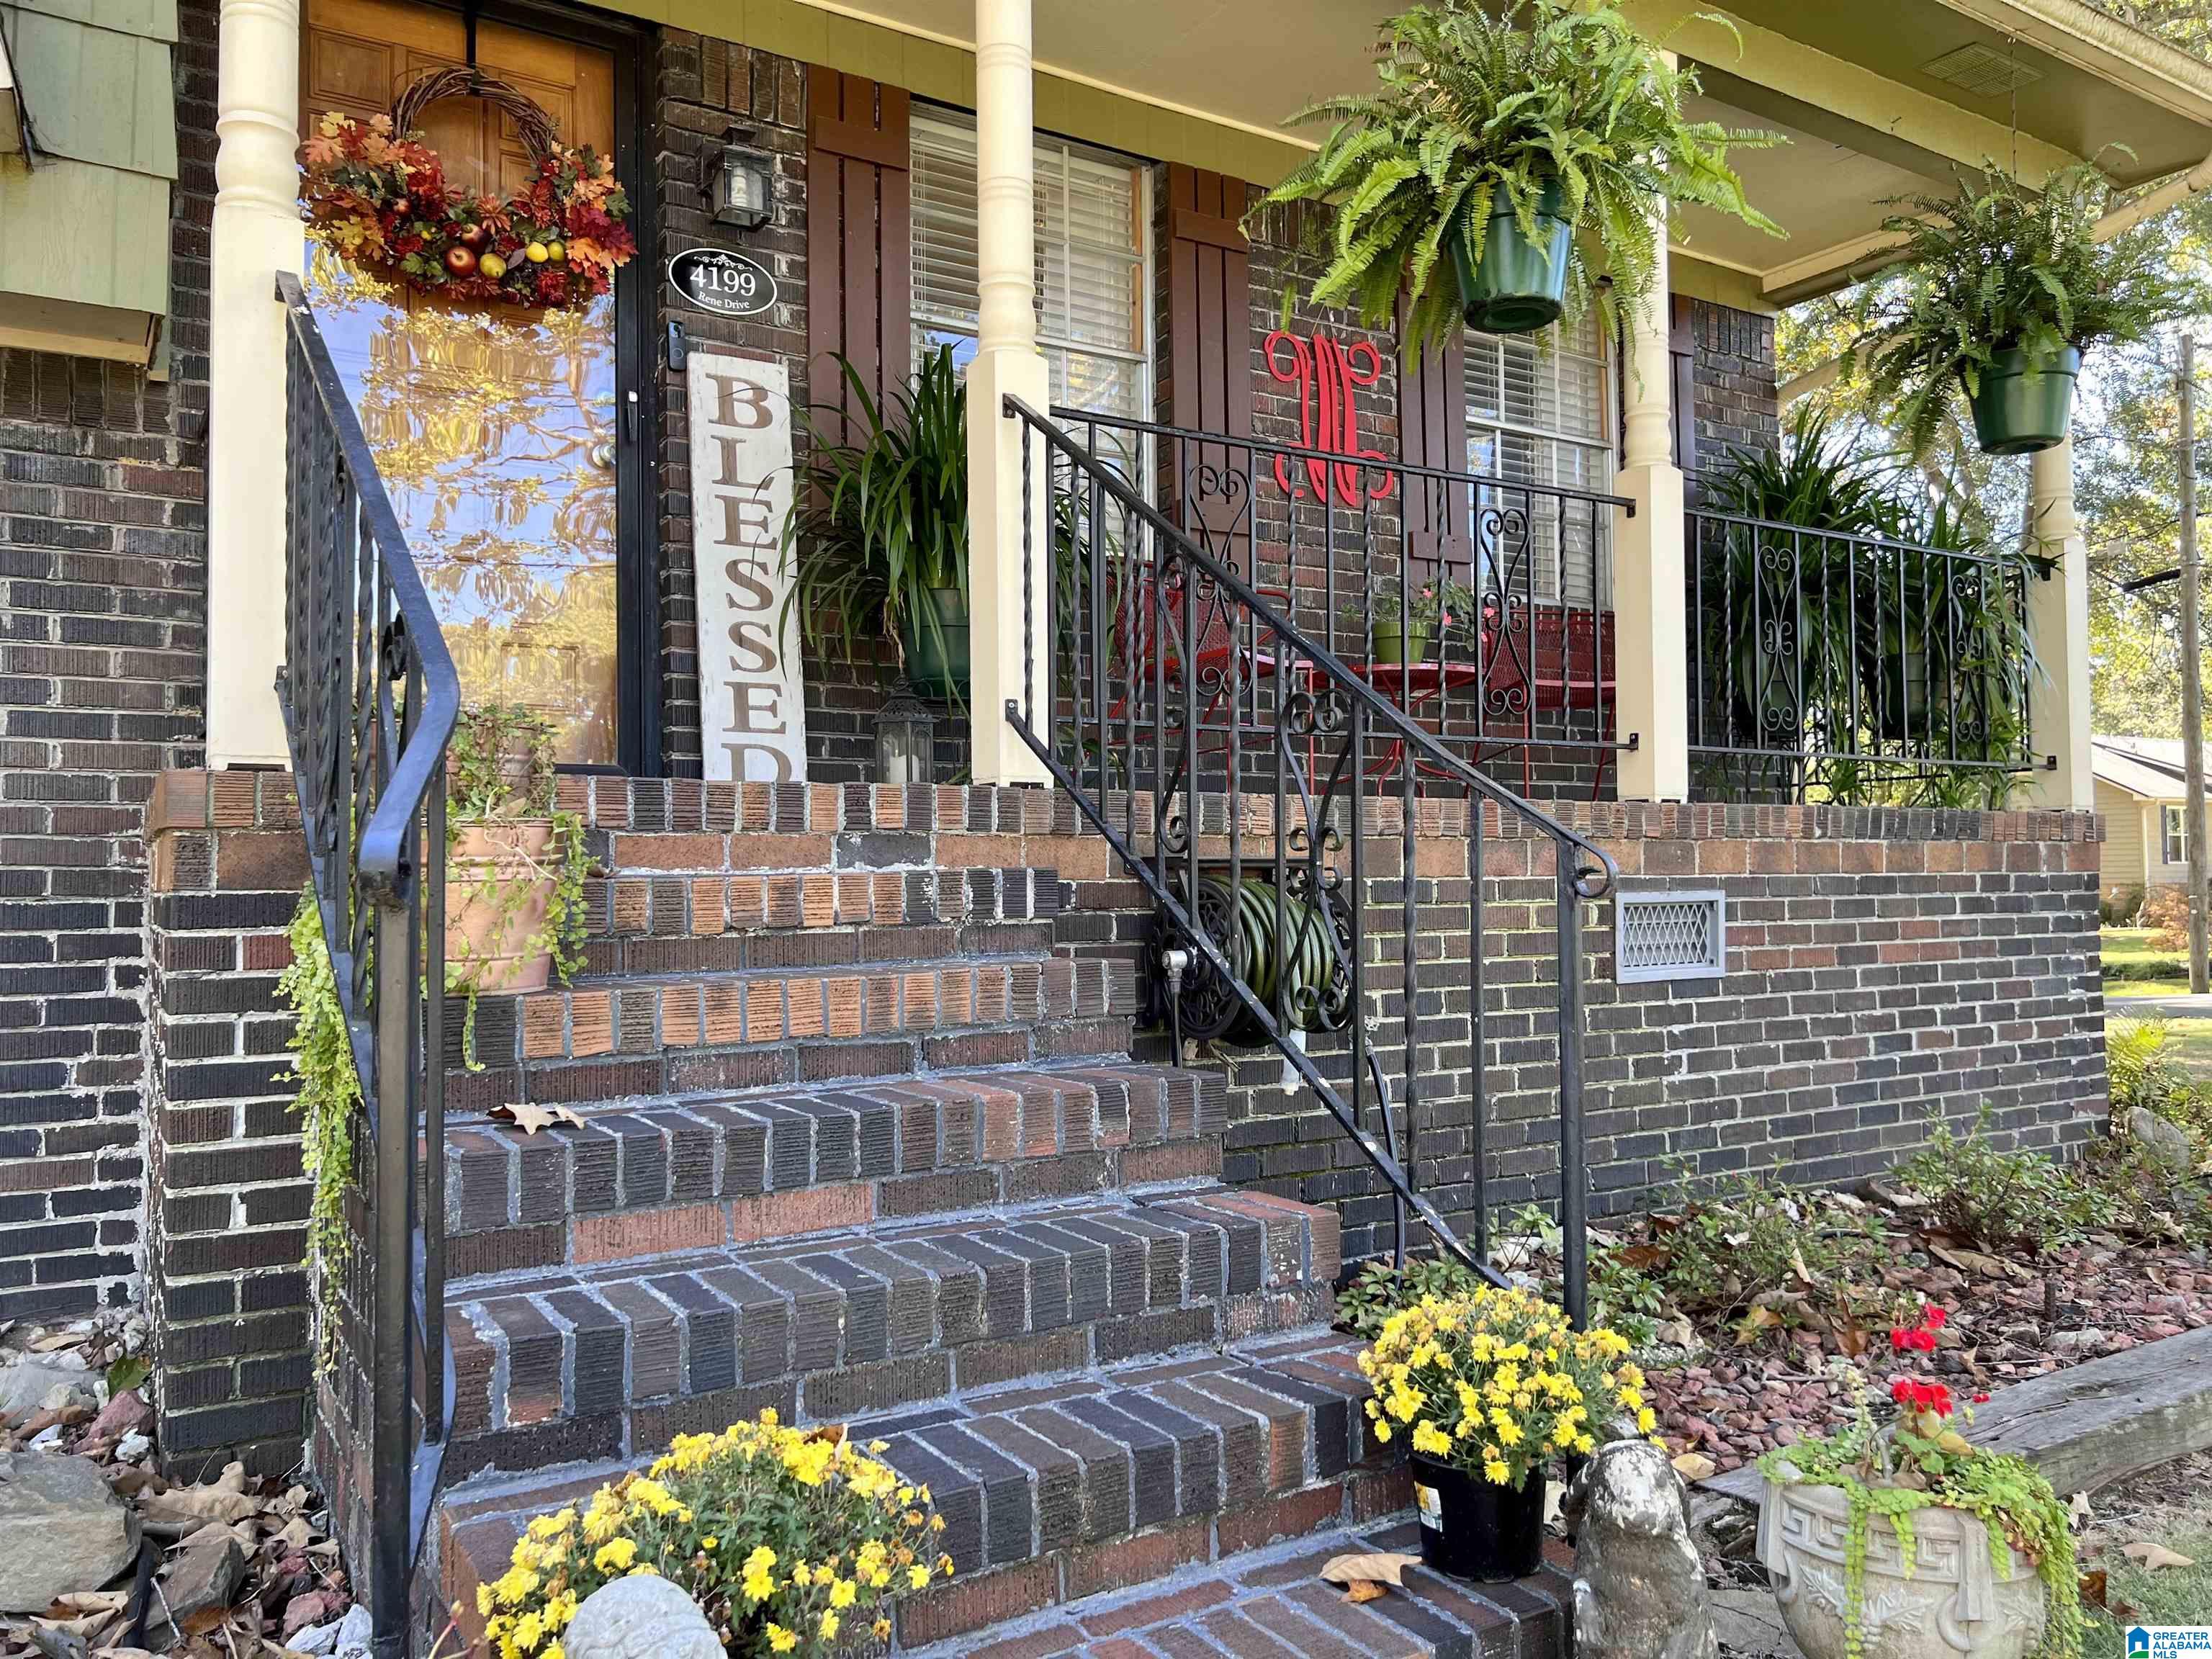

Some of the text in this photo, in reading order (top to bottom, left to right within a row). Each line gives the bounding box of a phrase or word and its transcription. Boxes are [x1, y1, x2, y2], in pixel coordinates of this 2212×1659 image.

[689, 264, 756, 297] 4199
[698, 291, 750, 309] Rene Drive
[705, 372, 793, 782] BLESSED
